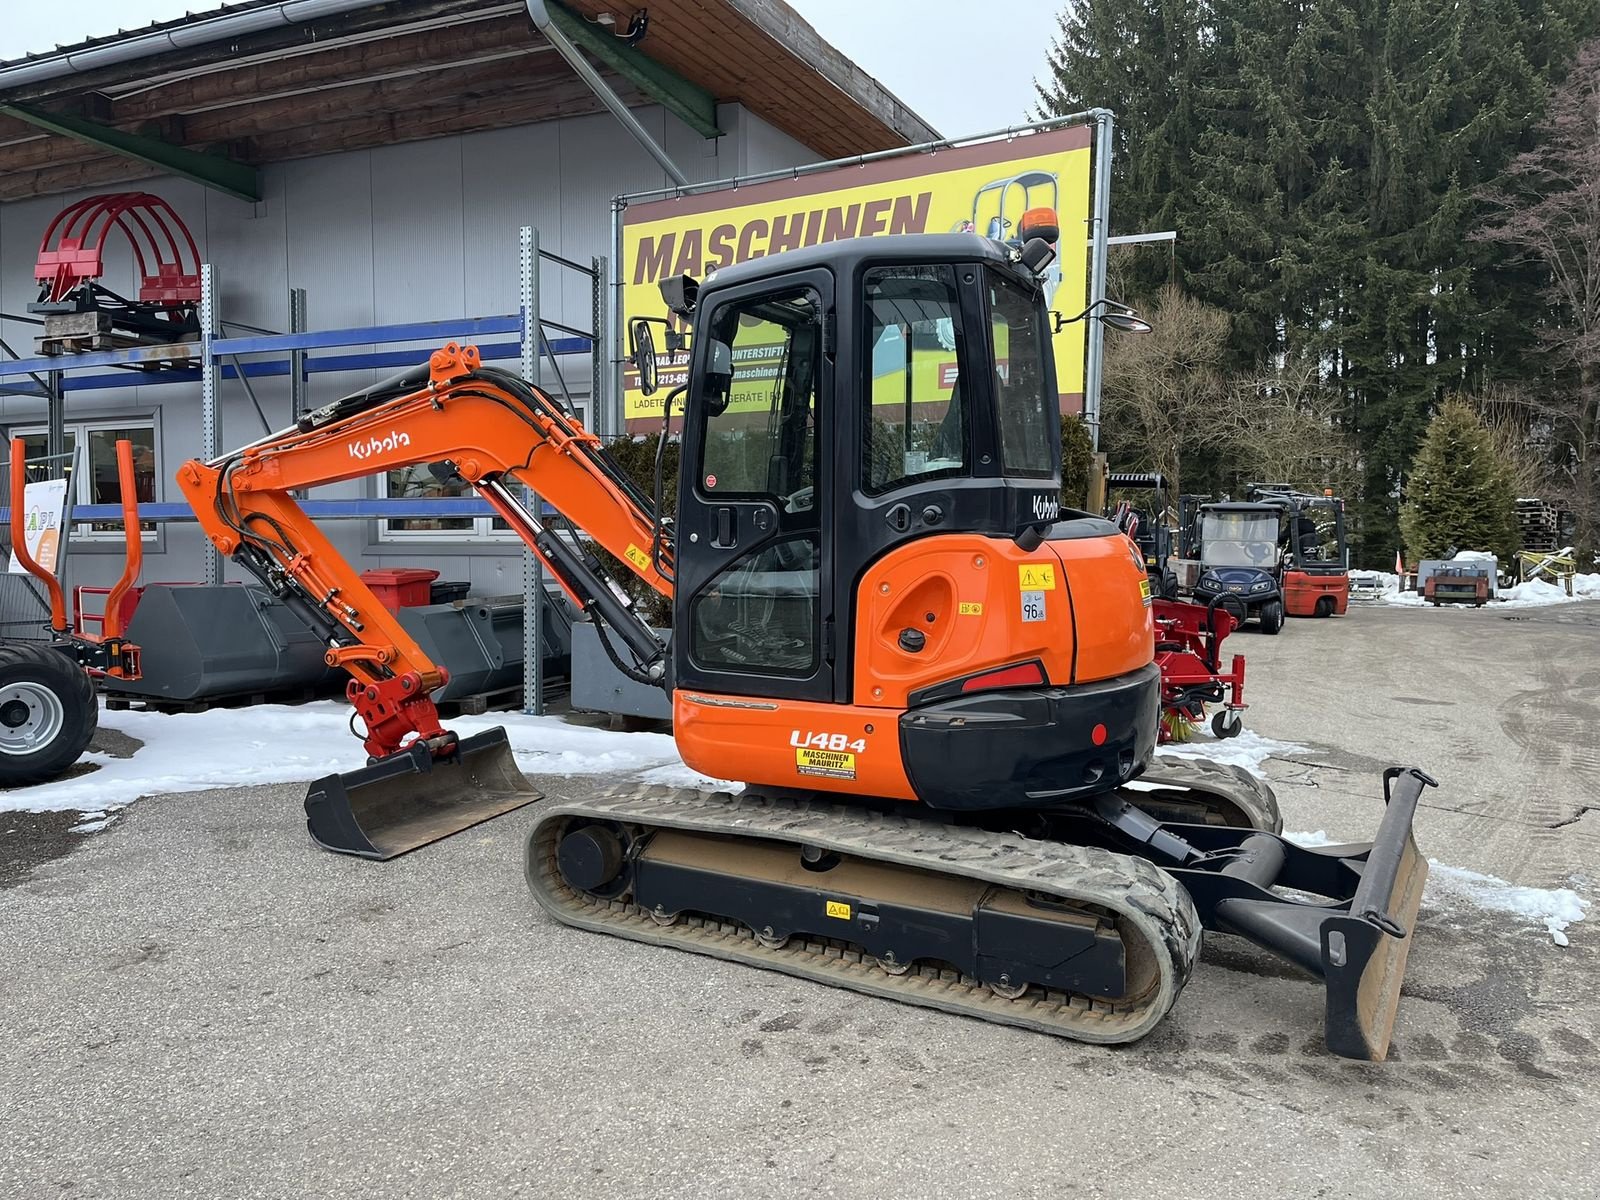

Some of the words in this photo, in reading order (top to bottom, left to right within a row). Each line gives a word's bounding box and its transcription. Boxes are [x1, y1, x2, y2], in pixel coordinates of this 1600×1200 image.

[633, 192, 932, 285] MASCHINEN
[348, 430, 411, 459] Kubota
[1033, 495, 1058, 520] Kubota
[1023, 604, 1038, 619] 96
[802, 750, 850, 762] MASCHINEN
[808, 758, 844, 769] MAURITZ
